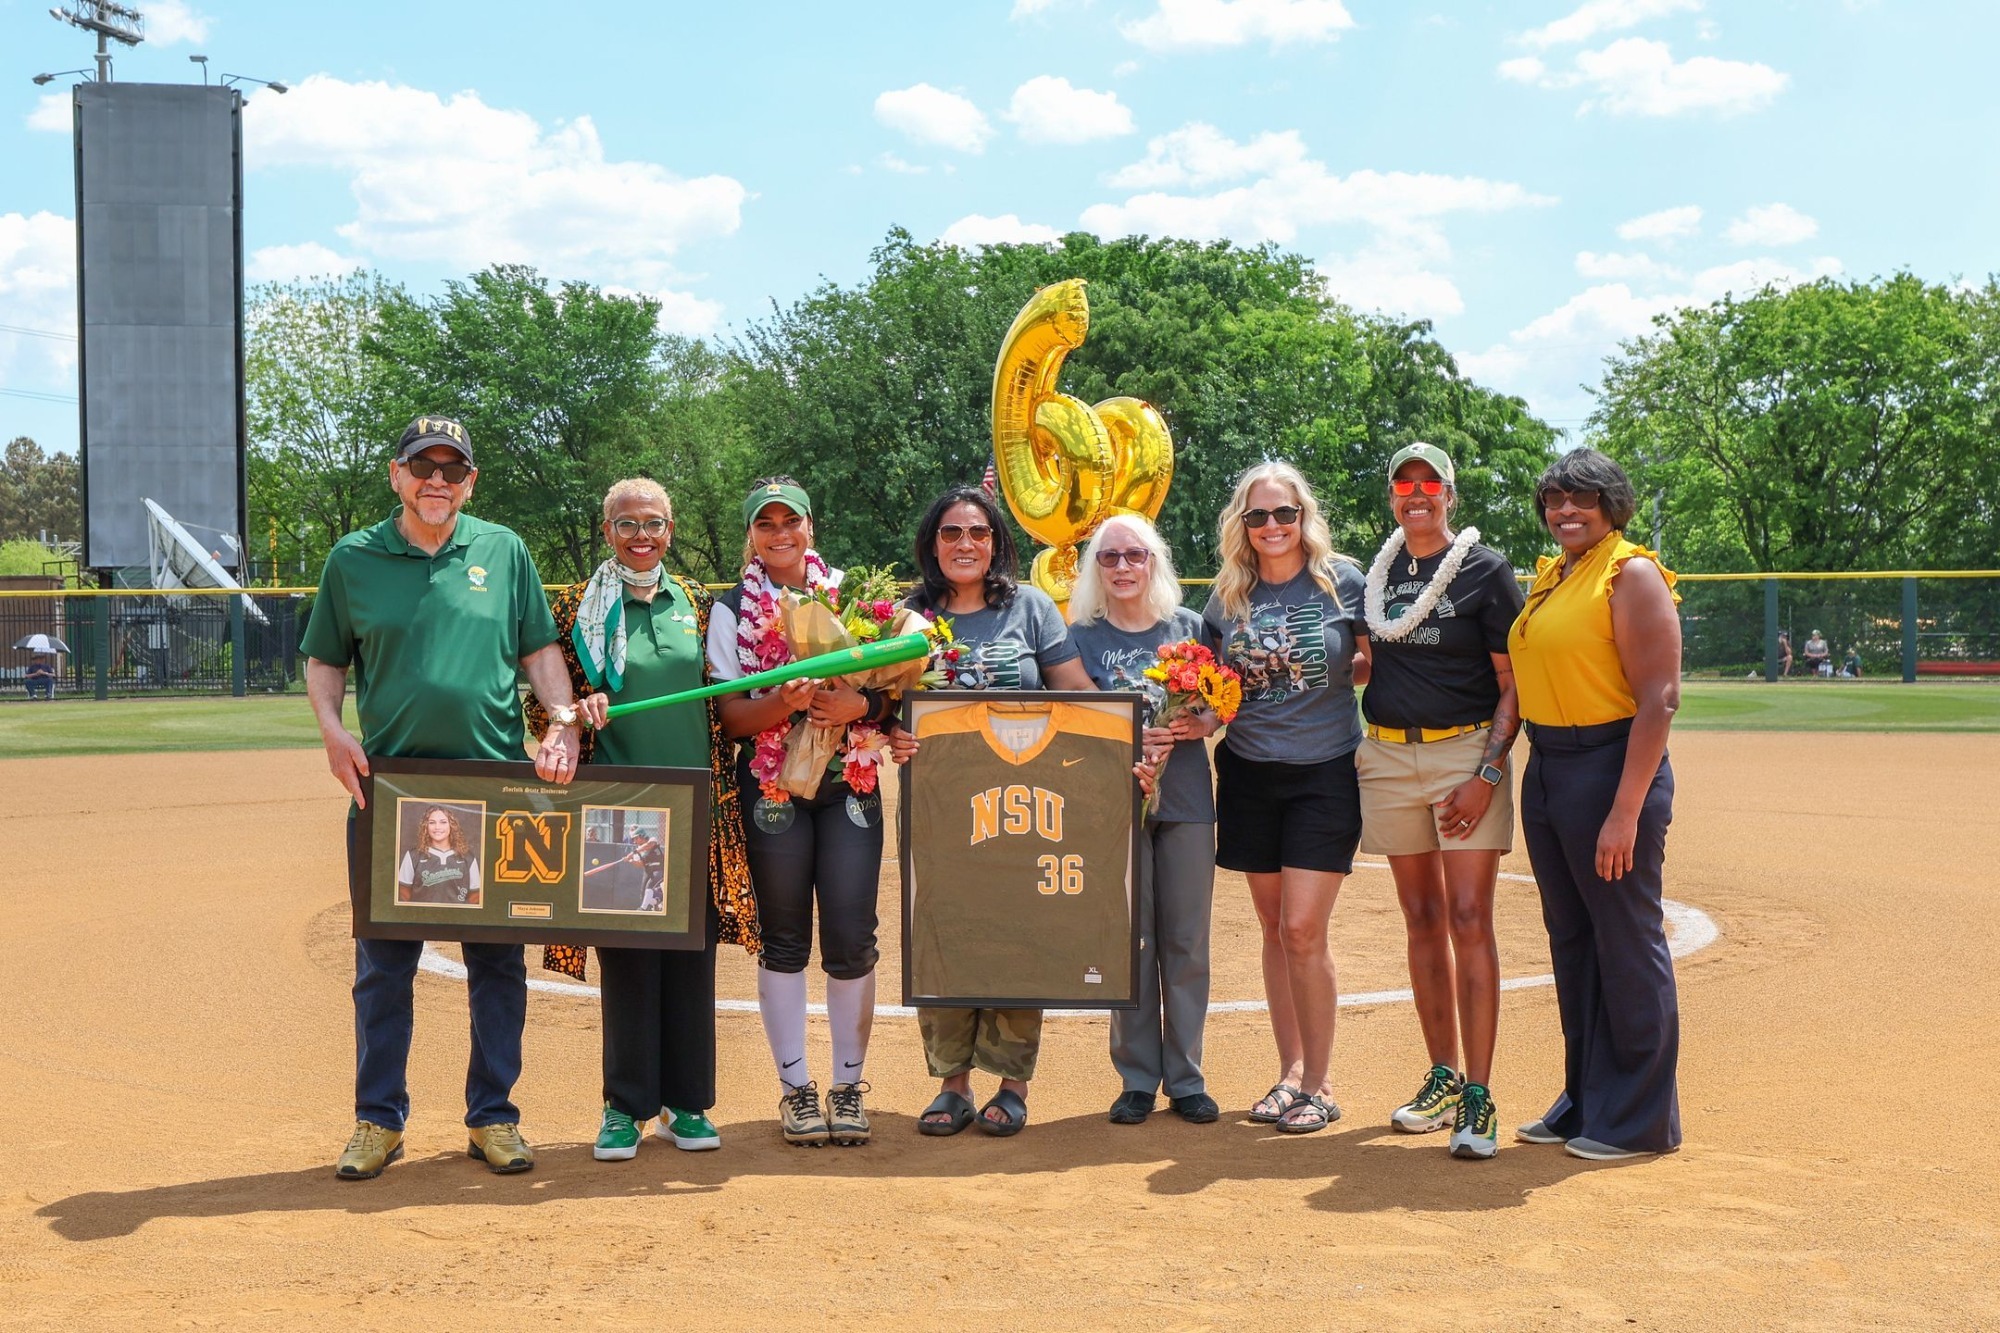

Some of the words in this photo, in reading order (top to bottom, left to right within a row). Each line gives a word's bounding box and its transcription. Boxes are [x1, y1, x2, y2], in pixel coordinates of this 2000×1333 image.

[1101, 647, 1153, 670] Maya
[1285, 602, 1329, 692] JOHNSON
[767, 811, 780, 823] Of
[970, 784, 1065, 846] NSU
[494, 809, 571, 884] N
[1037, 854, 1084, 895] 36
[1088, 966, 1099, 974] XL
